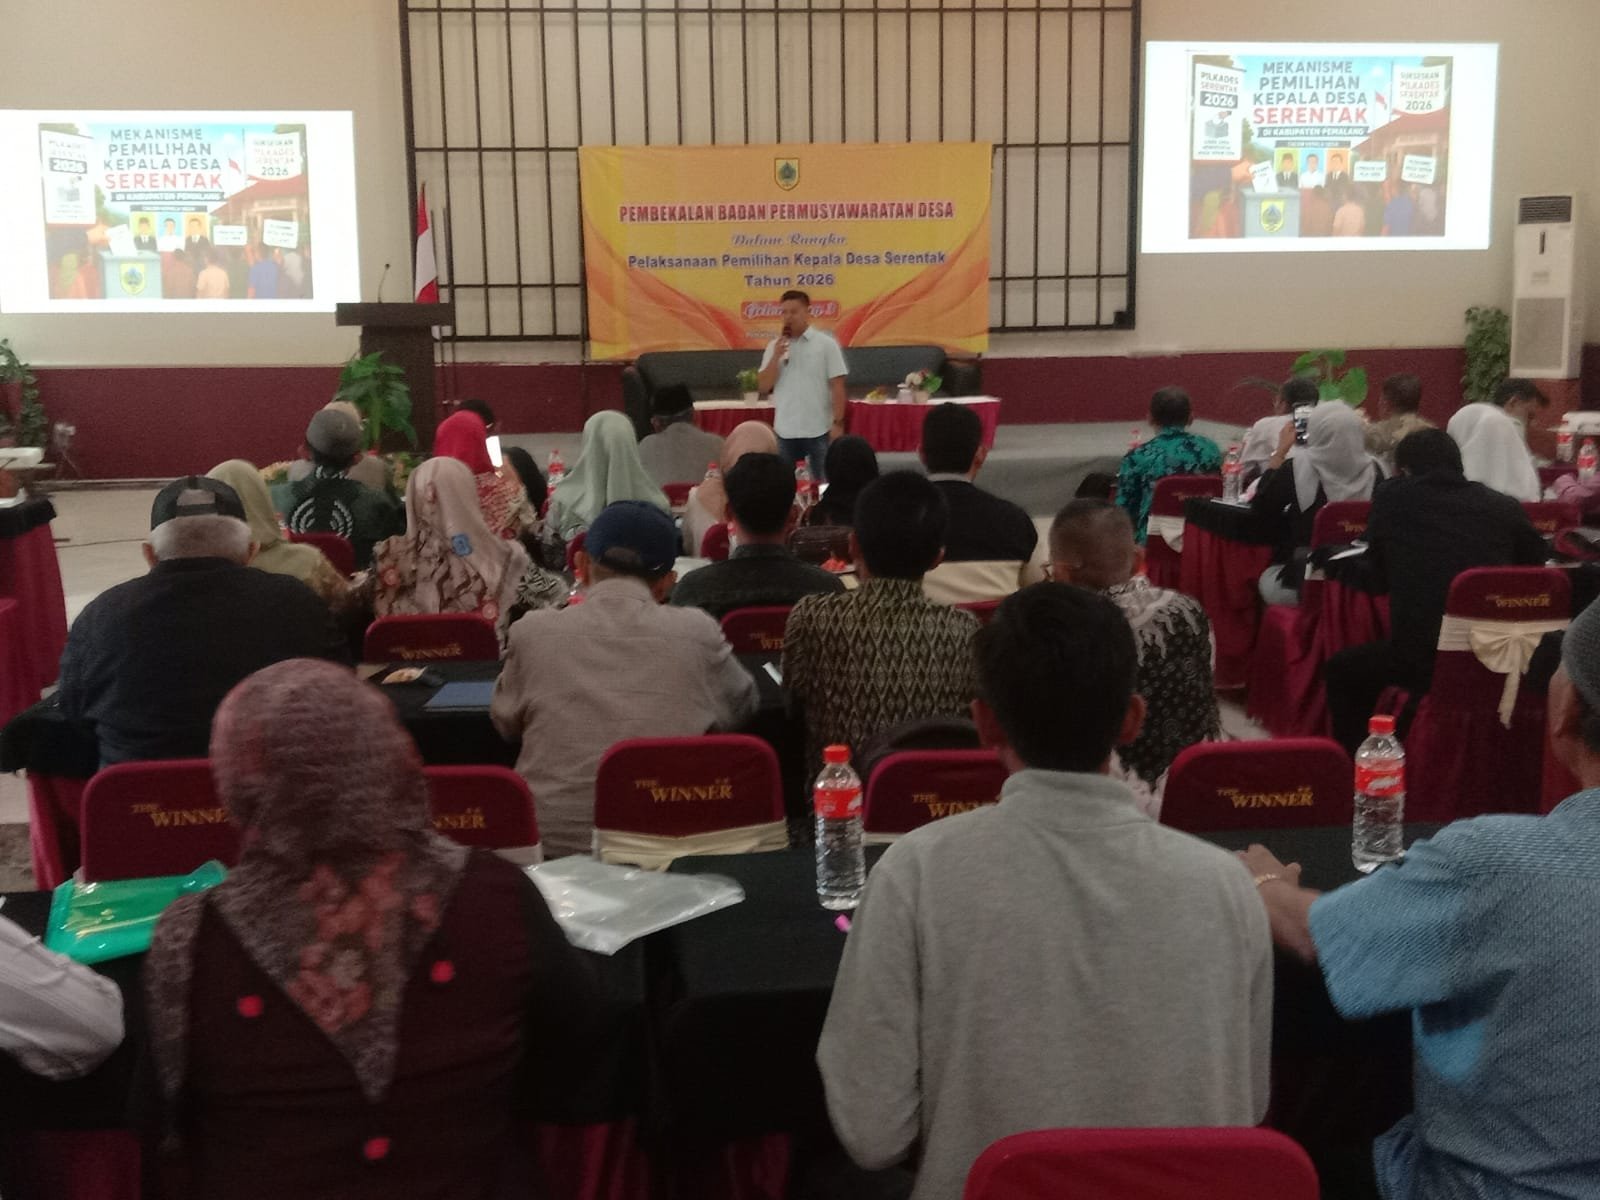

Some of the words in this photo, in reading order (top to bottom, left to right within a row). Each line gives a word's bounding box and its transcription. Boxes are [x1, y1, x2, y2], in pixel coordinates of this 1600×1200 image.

[1262, 61, 1352, 74] MEKANISME
[1200, 71, 1239, 84] PILKADES
[1259, 75, 1360, 90] PEMILIHAN
[1203, 93, 1235, 107] 2026
[1253, 92, 1320, 105] KEPALA
[1325, 92, 1368, 105] DESA
[1405, 100, 1432, 111] 2026
[1253, 107, 1368, 124] SERENTAK
[110, 128, 204, 141] MEKANISME
[108, 143, 212, 157] PEMILIHAN
[103, 158, 171, 171] KEPALA
[178, 158, 222, 170] DESA
[261, 166, 289, 177] 2026
[105, 172, 223, 189] SERENTAK
[619, 204, 714, 223] PEMBEKALAN
[717, 203, 766, 221] BADAN
[770, 202, 914, 220] PERMUSYAWARATAN
[917, 201, 954, 219] DESA
[732, 233, 783, 246] Dalam
[628, 255, 717, 268] Pelaksanaan
[722, 253, 789, 267] Pemilihan
[794, 252, 842, 268] Kepala
[846, 252, 880, 265] Desa
[884, 251, 945, 264] Serentak
[744, 275, 791, 287] Tahun
[797, 274, 835, 286] 2026
[400, 645, 464, 660] WINNER
[648, 783, 735, 803] WINNER
[1231, 791, 1313, 809] WINNER
[150, 807, 227, 828] WINNE
